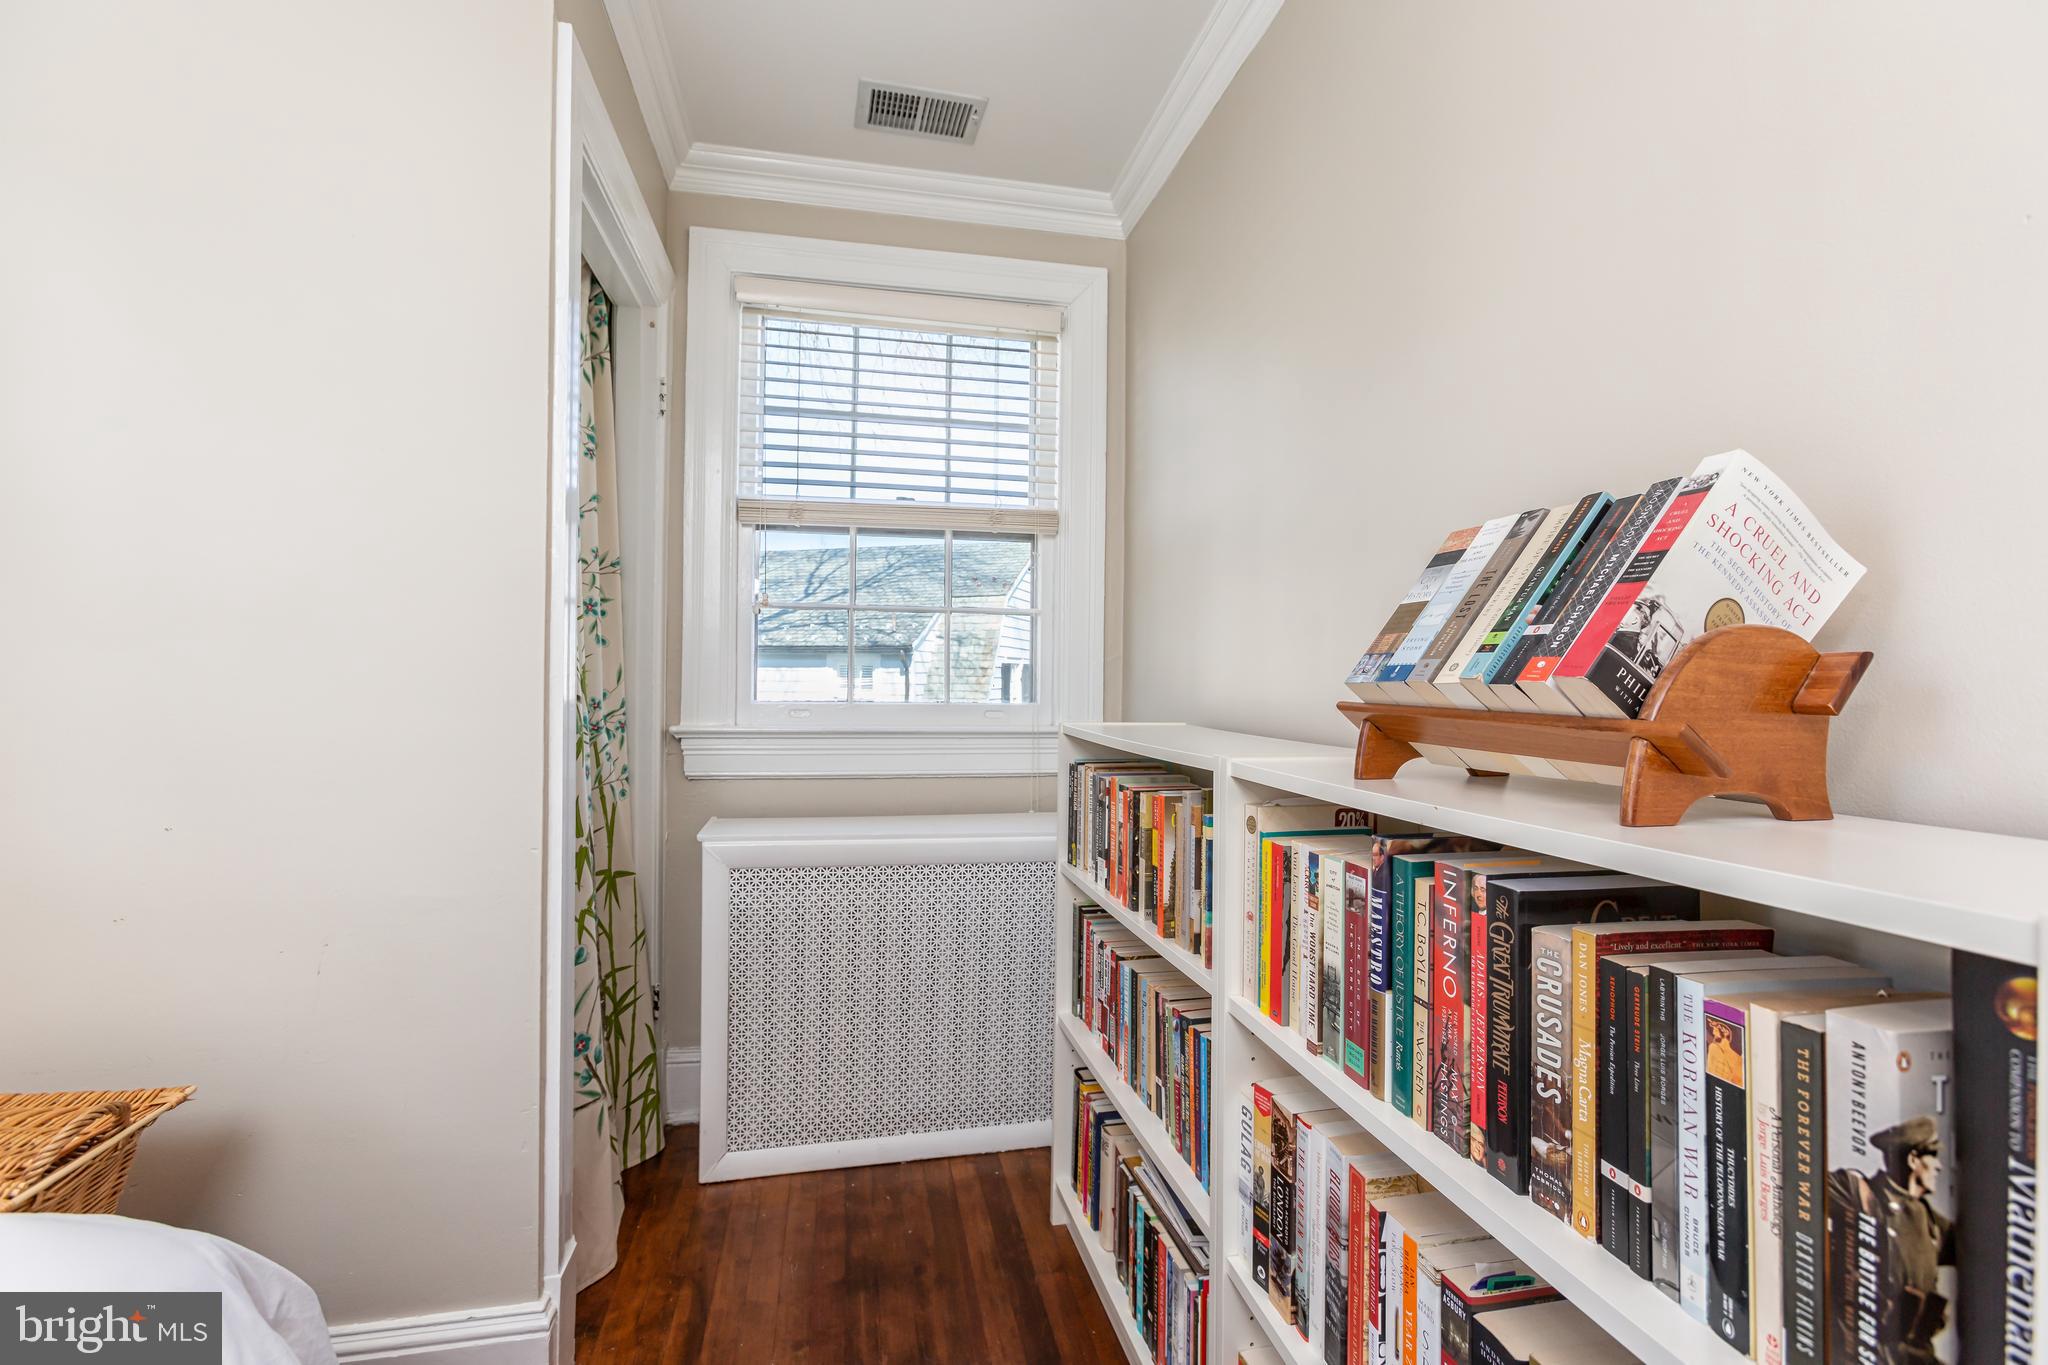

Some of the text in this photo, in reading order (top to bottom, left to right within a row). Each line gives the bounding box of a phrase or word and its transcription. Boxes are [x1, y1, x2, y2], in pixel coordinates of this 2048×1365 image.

[1619, 488, 1664, 548] MOONGLOW
[1743, 467, 1850, 578] NEW YORK TIMES BESTSELLER
[1582, 553, 1620, 602] MICHAEL
[1693, 542, 1711, 559] THE
[1712, 558, 1746, 595] KENNEDY
[1706, 514, 1784, 596] SHOCKING
[1784, 597, 1815, 627] ACT
[1725, 503, 1821, 605] A CRUEL AND
[1456, 568, 1498, 619] THE LOST
[1504, 566, 1545, 622] QUANTUM MAN
[1710, 541, 1792, 630] THE SECRET HISTORY OF
[1550, 605, 1584, 648] CHABON
[1339, 811, 1366, 827] 20%
[1442, 870, 1457, 999] INFERNO
[1495, 895, 1509, 920] The
[1309, 931, 1317, 968] WORST
[1369, 895, 1383, 986] MAESTRO
[1416, 901, 1427, 988] T.C. BOYLE
[1488, 921, 1515, 978] GREAT
[1541, 947, 1559, 959] THE
[1308, 969, 1316, 998] HARD
[1395, 874, 1405, 1072] A THEORY OF JUSTICE Rawls
[1476, 950, 1485, 999] ADAMS
[1579, 943, 1588, 1013] DAN JONES
[1308, 1000, 1316, 1028] TIME
[1356, 1011, 1361, 1026] OF
[1489, 975, 1516, 1076] TRIUMVIRATE
[1536, 957, 1563, 1105] CRUSADES
[1415, 1038, 1425, 1097] WOMEN
[1475, 1012, 1485, 1093] JEFFERSON
[1574, 1037, 1592, 1122] Magna Carta
[1607, 1062, 1616, 1095] Expedition
[1440, 1061, 1448, 1137] HASTINGS
[1682, 994, 1699, 1200] THE KOREAN WAR
[1852, 1041, 1866, 1157] ANTONY BEEVOR
[2008, 1048, 2024, 1152] COMPANION TO
[1240, 1105, 1252, 1172] GULAG
[1716, 1127, 1722, 1141] OF
[1757, 1120, 1769, 1149] Jorge
[1772, 1124, 1782, 1175] Personal
[1797, 1048, 1811, 1222] THE FOREVER WAR
[1531, 1173, 1565, 1197] ASBRIDGE
[1534, 1166, 1563, 1187] THOMAS
[1727, 1148, 1735, 1209] THUCYDIDES
[1760, 1153, 1769, 1178] Luis
[1276, 1176, 1284, 1241] LONDON
[1329, 1169, 1341, 1269] BLOODLANDS
[1716, 1162, 1724, 1237] PELOPONNESIAN
[1759, 1182, 1769, 1222] Borges
[1770, 1176, 1783, 1240] Anthology
[1858, 1211, 1877, 1247] THE
[1717, 1239, 1725, 1261] WAR
[1858, 1247, 1878, 1312] BATTLE
[1442, 1294, 1467, 1321] ASBURY
[1795, 1231, 1814, 1357] DEXTER FILKINS
[1858, 1311, 1877, 1347] FOR
